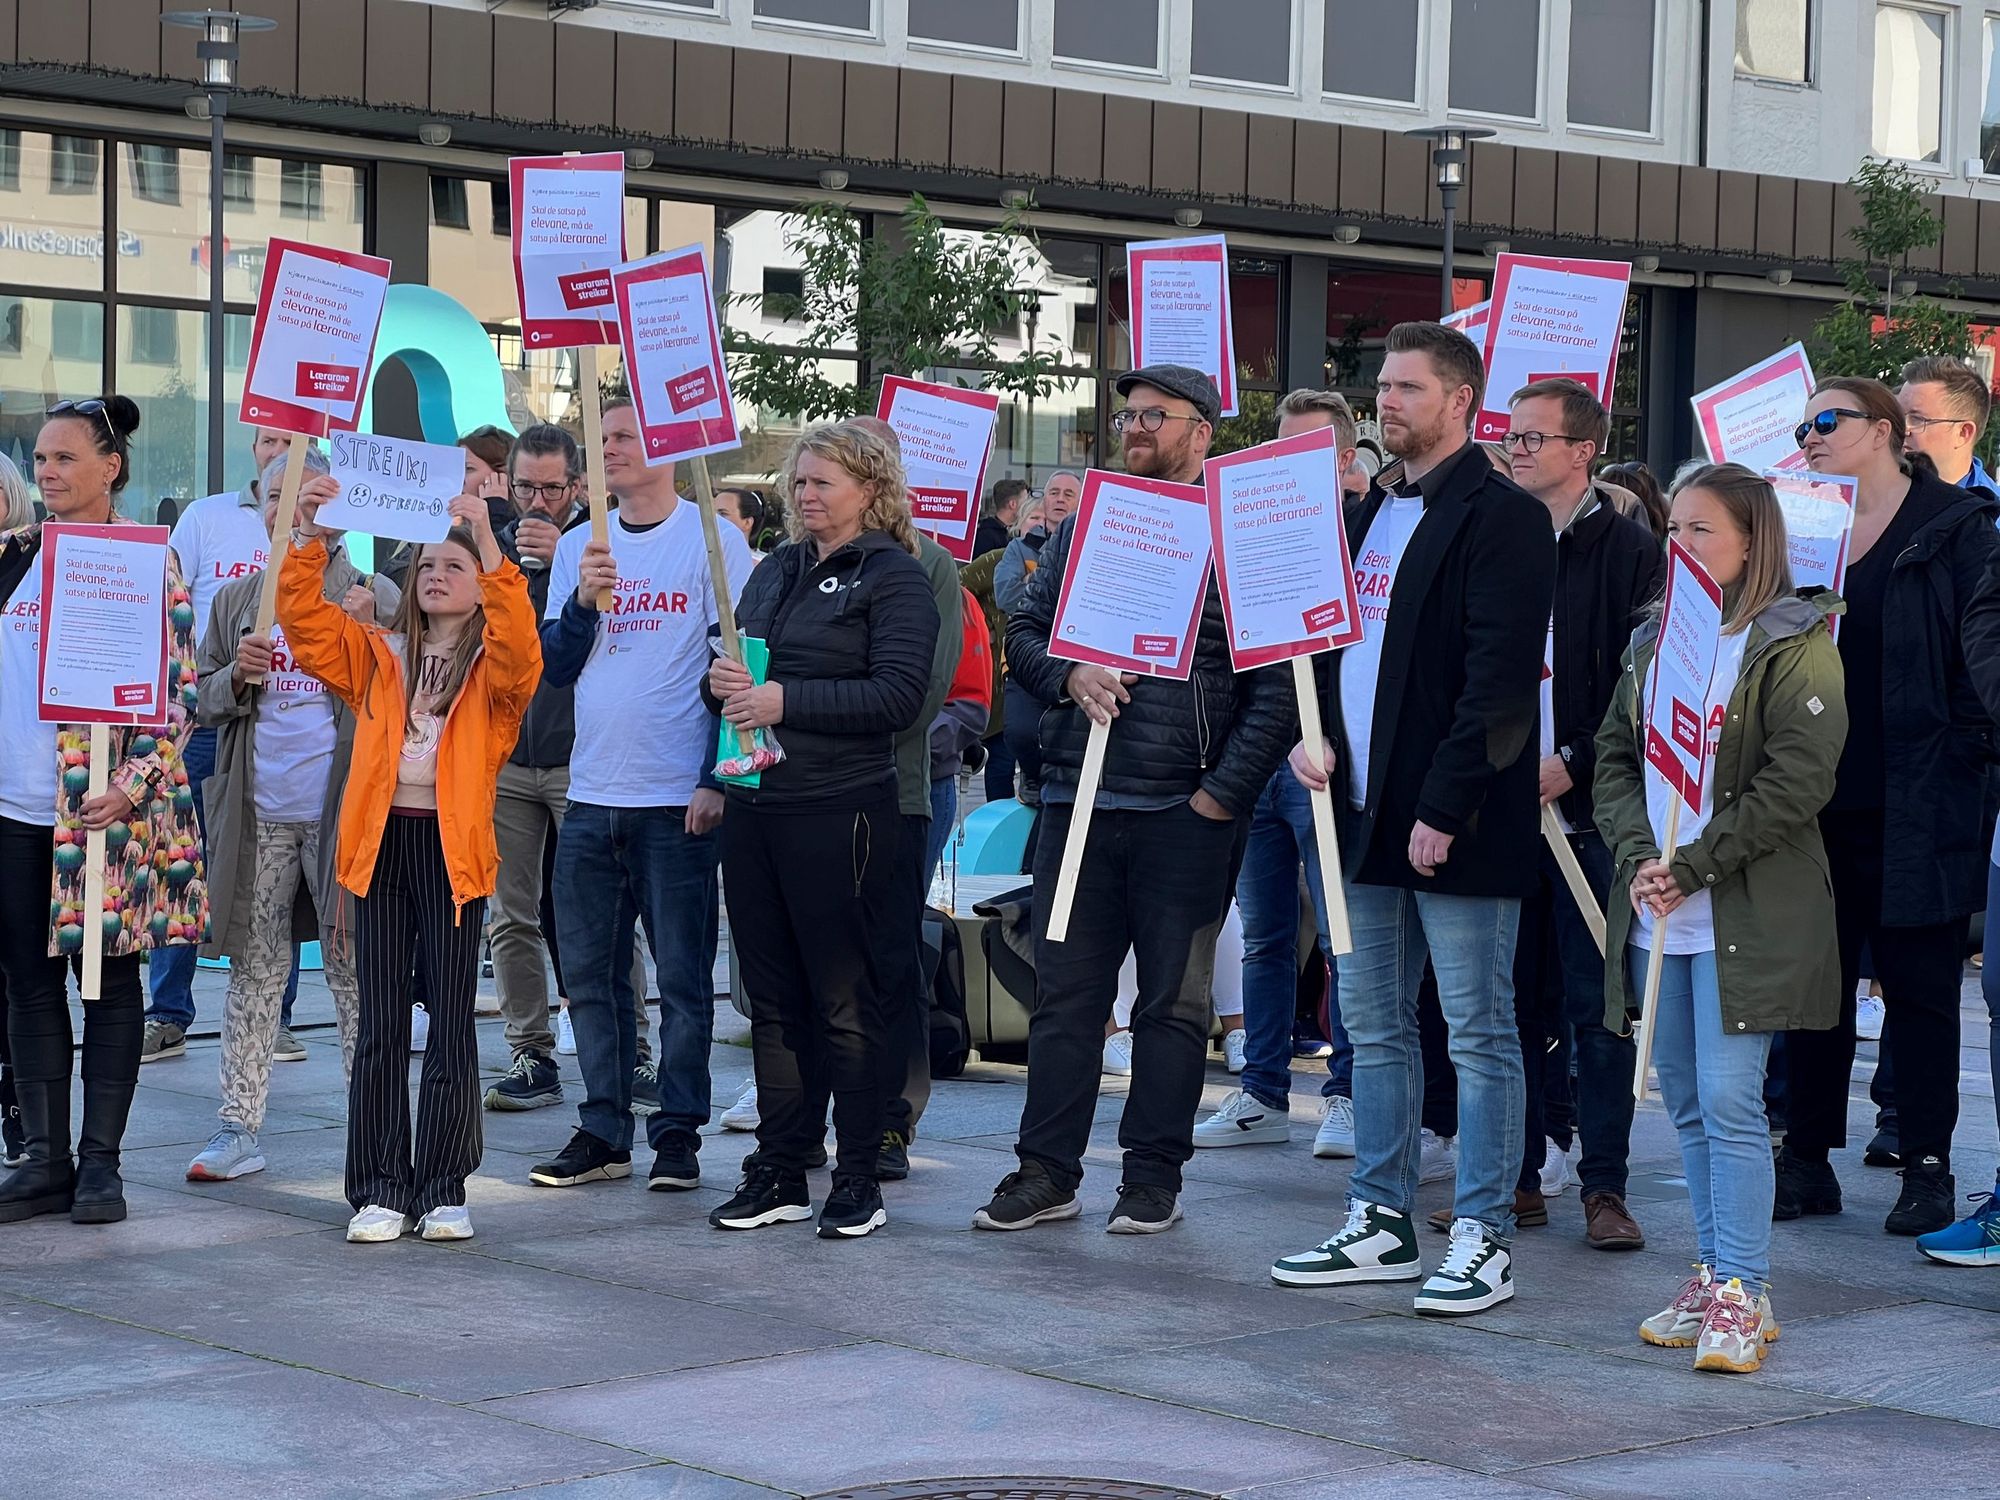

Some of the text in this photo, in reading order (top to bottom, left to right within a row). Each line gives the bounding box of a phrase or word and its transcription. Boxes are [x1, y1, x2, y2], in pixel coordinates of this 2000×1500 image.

[531, 205, 546, 214] Skal
[547, 206, 556, 214] de
[576, 206, 586, 217] på
[530, 216, 593, 230] elevane, må de
[529, 231, 607, 245] satsa på lærarane!
[570, 278, 609, 291] Lærarane
[283, 286, 348, 312] Skal de satsa på
[578, 288, 609, 300] streikar
[280, 297, 352, 326] elevane, må de
[1513, 300, 1578, 318] Skal de satsa på
[277, 313, 362, 344] satsa på lærarane!
[1510, 312, 1584, 332] elevane, må de
[1507, 328, 1598, 348] satsa på lærarane!
[310, 370, 349, 383] Lærarane
[314, 380, 345, 392] streikar
[895, 419, 952, 441] Skal de satsa på
[933, 442, 946, 451] må
[946, 445, 956, 454] de
[334, 434, 427, 488] STREIK!
[908, 448, 919, 457] på
[919, 448, 967, 469] lærarane!
[1232, 478, 1297, 500] Skal de satse på
[917, 494, 957, 504] Lærarane
[921, 503, 953, 512] streikar
[1232, 492, 1306, 514] elevane, må de
[1106, 505, 1125, 517] Skal
[1125, 511, 1137, 520] de
[1138, 514, 1161, 526] satse
[1161, 519, 1174, 530] på
[1233, 502, 1322, 530] satse på lærarane!
[1102, 517, 1180, 545] elevane, må de
[1098, 533, 1194, 562] satse på lærarane!
[65, 558, 127, 574] Skal de satse på
[1363, 550, 1391, 568] Berre
[65, 571, 135, 588] elevane, må de
[613, 577, 650, 592] Berre
[64, 587, 149, 604] satse på lærarane!
[608, 618, 662, 634] lærarar
